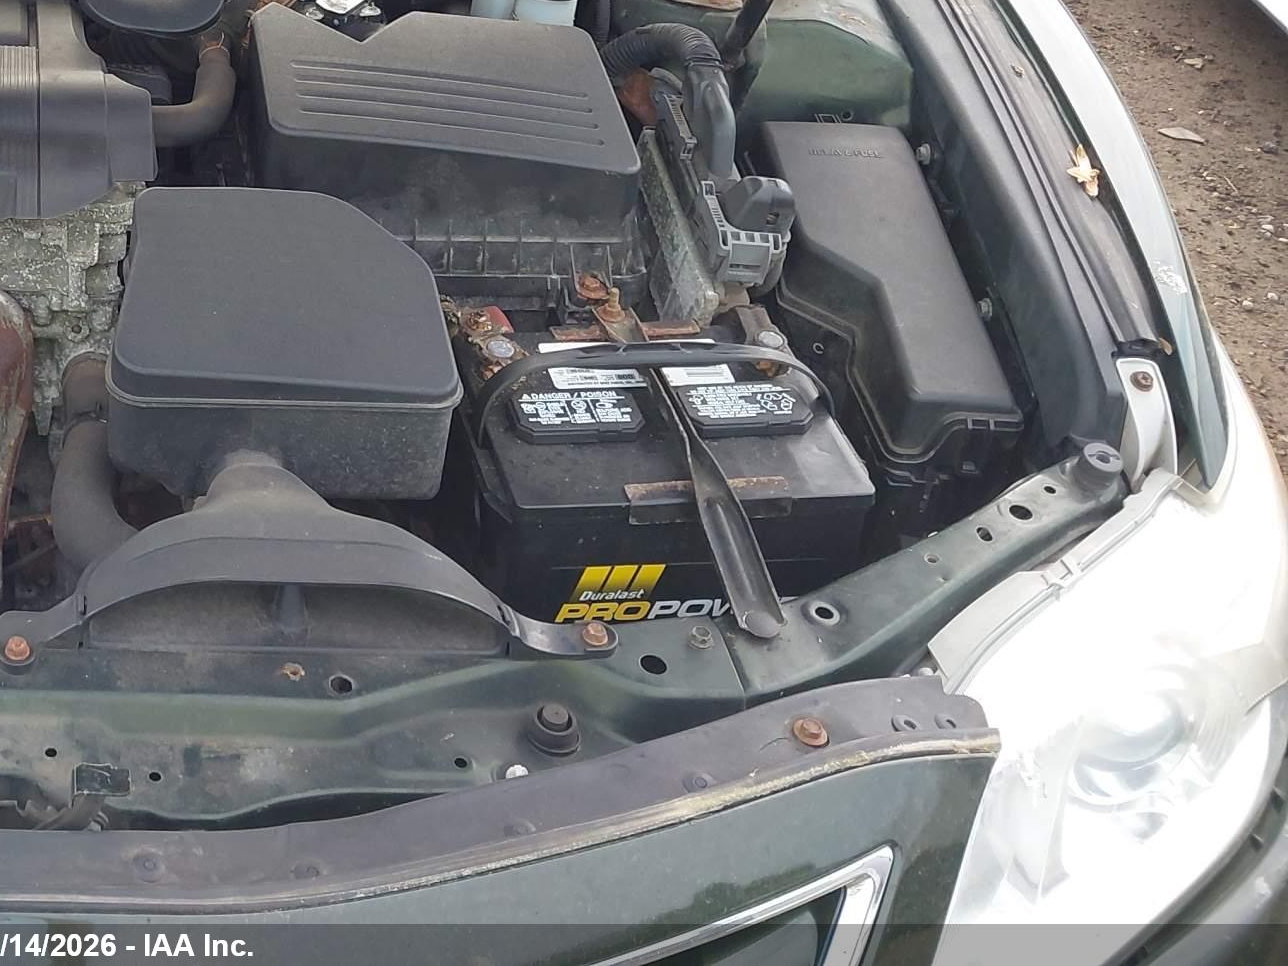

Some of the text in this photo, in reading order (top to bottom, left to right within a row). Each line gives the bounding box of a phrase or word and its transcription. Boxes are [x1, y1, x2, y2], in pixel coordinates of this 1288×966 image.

[531, 392, 571, 400] DANGER
[580, 390, 617, 399] POISON
[579, 589, 644, 601] Duralast
